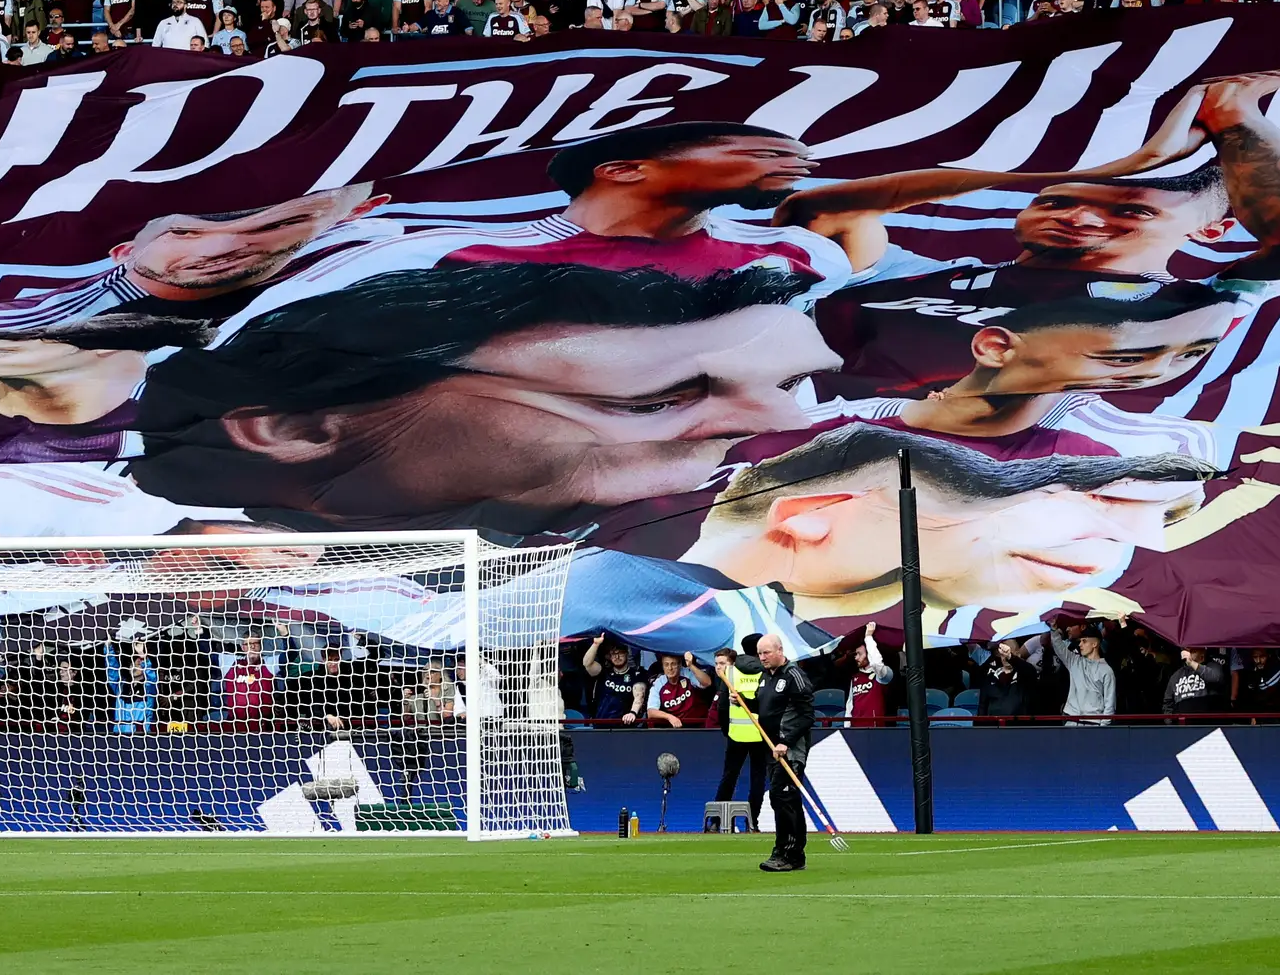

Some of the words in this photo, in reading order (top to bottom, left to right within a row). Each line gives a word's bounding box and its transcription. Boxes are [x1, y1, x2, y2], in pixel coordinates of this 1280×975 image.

[304, 62, 730, 195] THE
[861, 296, 1016, 327] Bet
[605, 680, 632, 692] CAZOO
[664, 691, 691, 708] CAZOO
